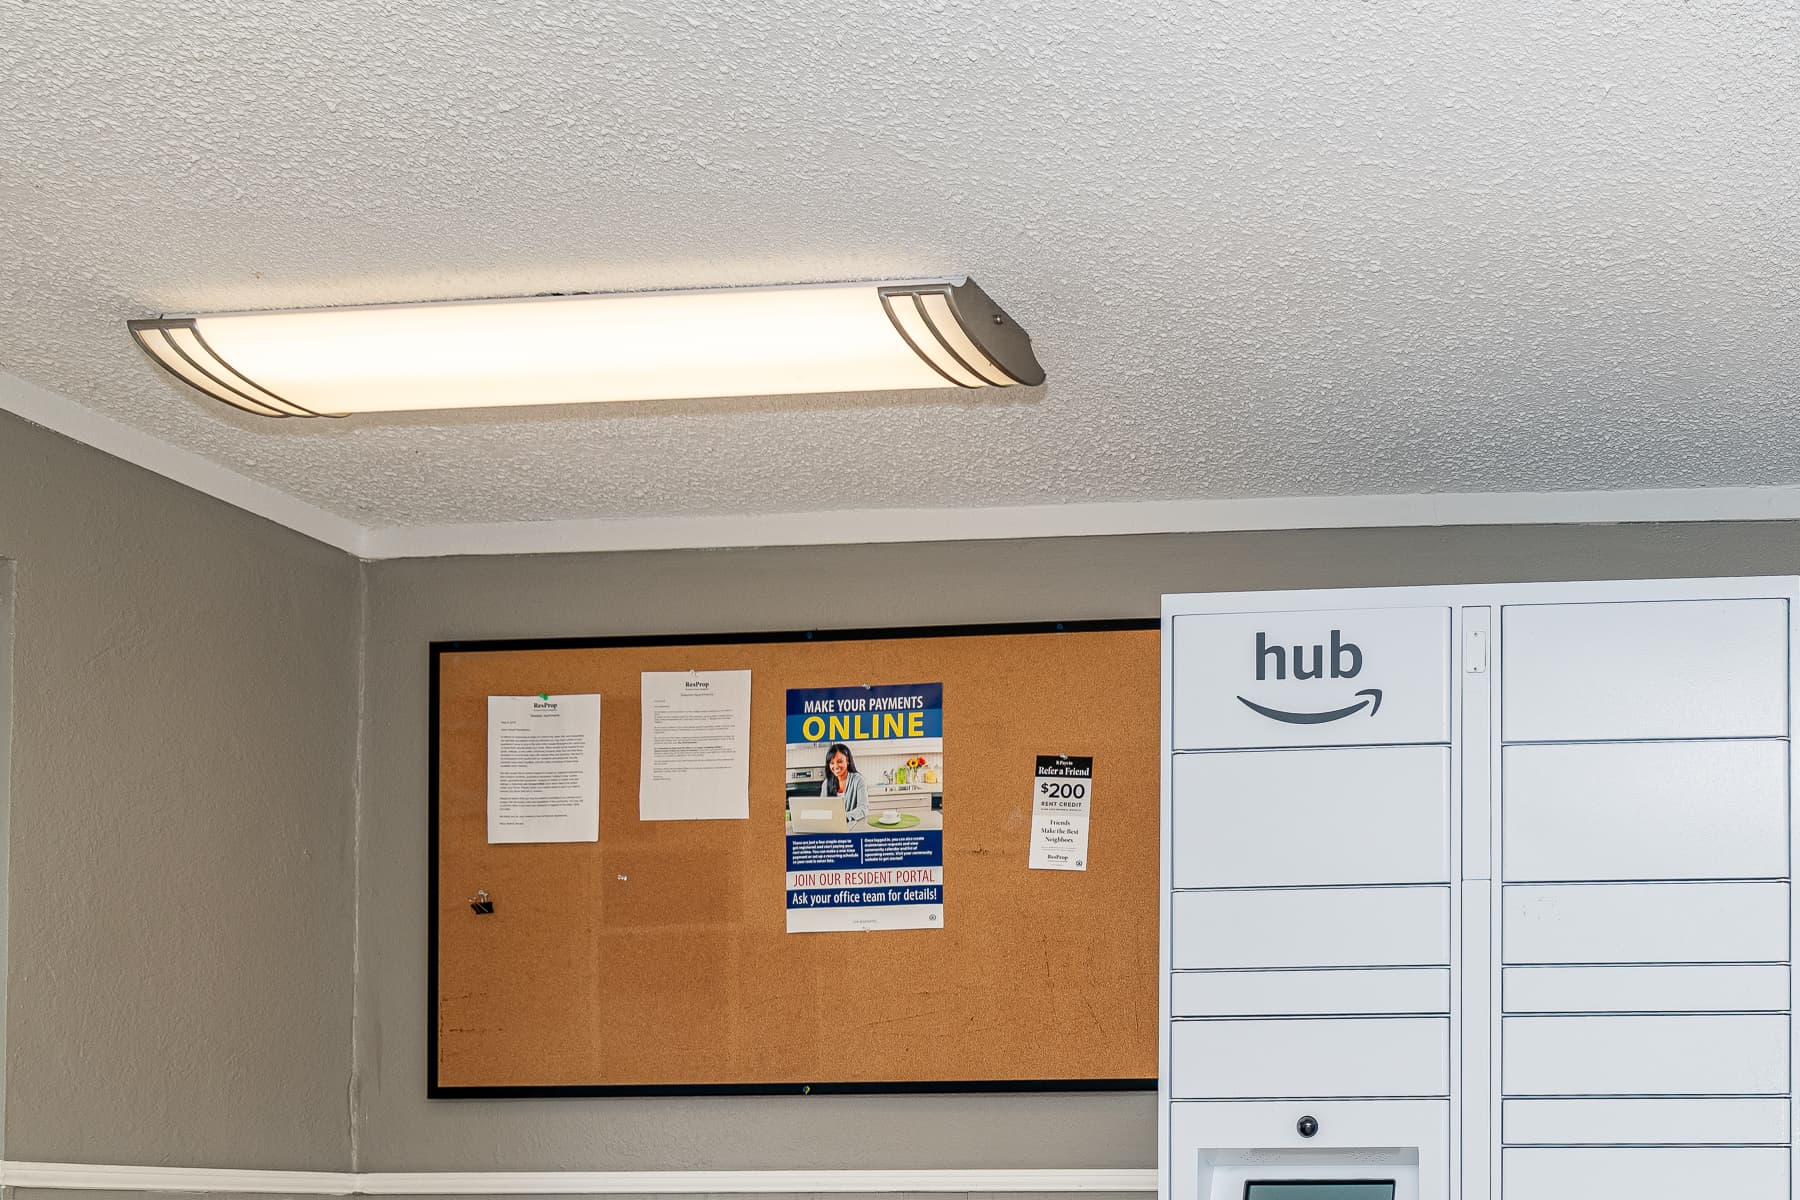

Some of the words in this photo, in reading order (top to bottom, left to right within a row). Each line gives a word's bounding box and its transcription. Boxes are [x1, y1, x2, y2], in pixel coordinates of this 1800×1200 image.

[1256, 630, 1362, 680] hub
[534, 702, 558, 710] ResProp
[804, 700, 834, 713] MAKE
[838, 699, 866, 712] YOUR
[869, 696, 923, 711] PAYMENTS
[802, 712, 924, 741] ONLINE
[1038, 766, 1058, 775] Refer
[1065, 767, 1090, 776] Friend
[1041, 782, 1085, 799] $200
[794, 874, 816, 887] JOIN
[819, 872, 841, 886] OUR
[845, 871, 891, 885] RESIDENT
[896, 870, 935, 883] PORTAL
[792, 892, 808, 905] Ask
[810, 893, 831, 906] your
[834, 891, 860, 904] office
[862, 891, 885, 902] team
[888, 889, 901, 901] for
[904, 888, 937, 901] details!
